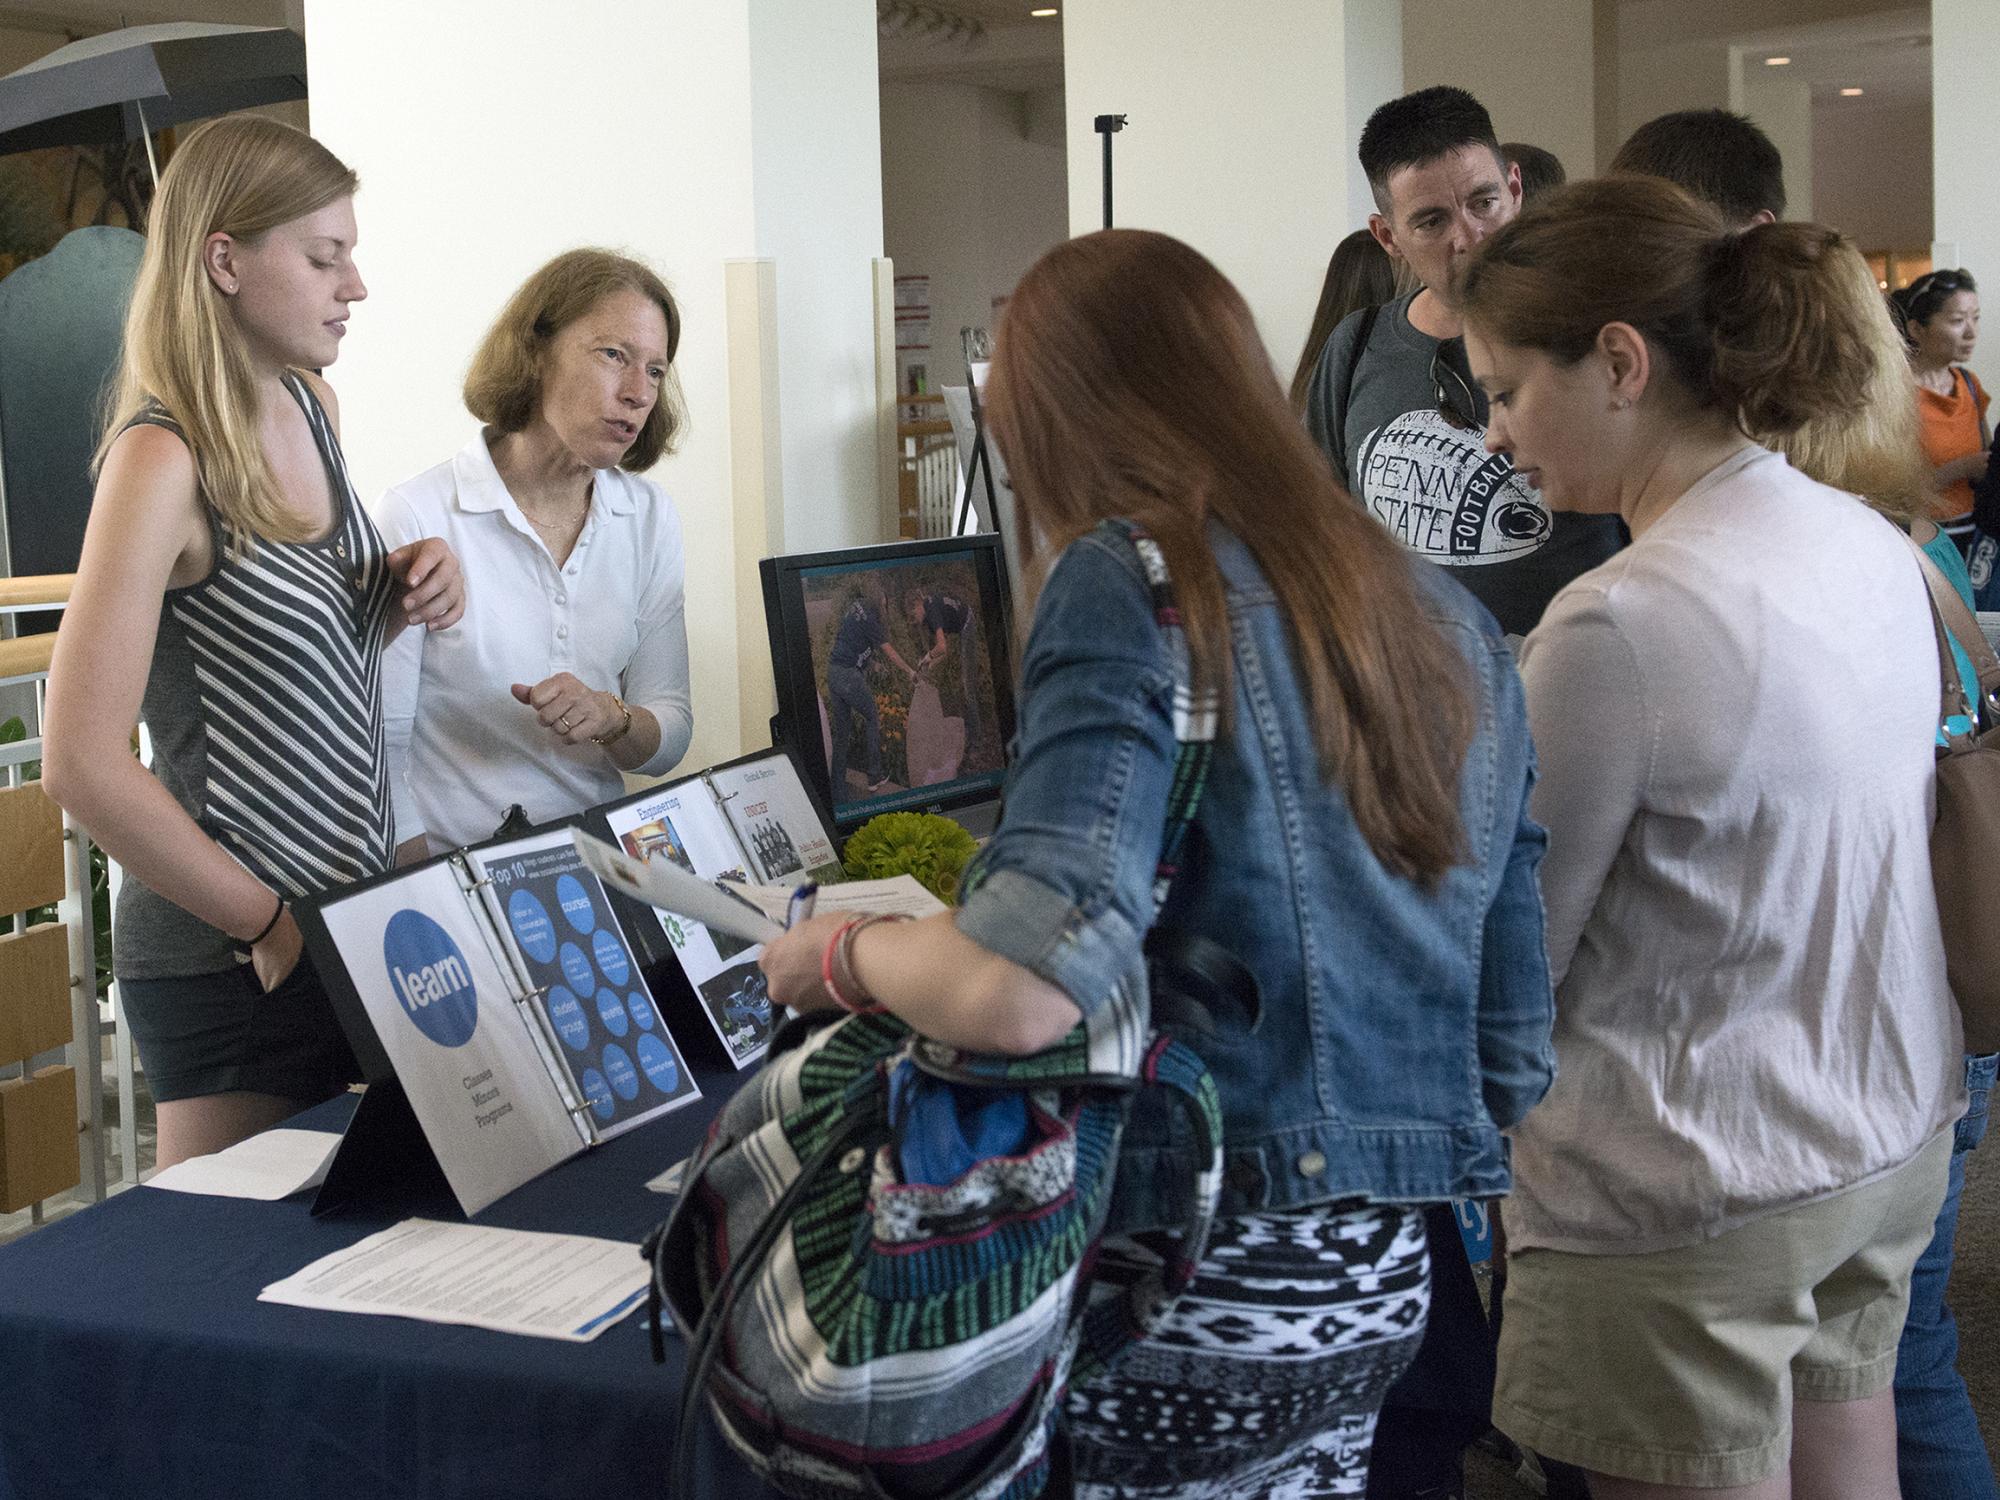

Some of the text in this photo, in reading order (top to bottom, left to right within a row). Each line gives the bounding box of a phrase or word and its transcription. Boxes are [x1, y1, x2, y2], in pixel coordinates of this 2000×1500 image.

[1368, 454, 1457, 503] PENN
[1455, 453, 1515, 552] FOOTBALL
[1373, 495, 1453, 551] STATE
[635, 797, 681, 821] Engineering
[487, 861, 525, 885] Top 10
[561, 896, 591, 913] courses
[393, 955, 470, 1012] learn
[553, 999, 578, 1017] student
[463, 1069, 493, 1090] Classes
[472, 1087, 500, 1107] Minors
[475, 1102, 513, 1128] Programs
